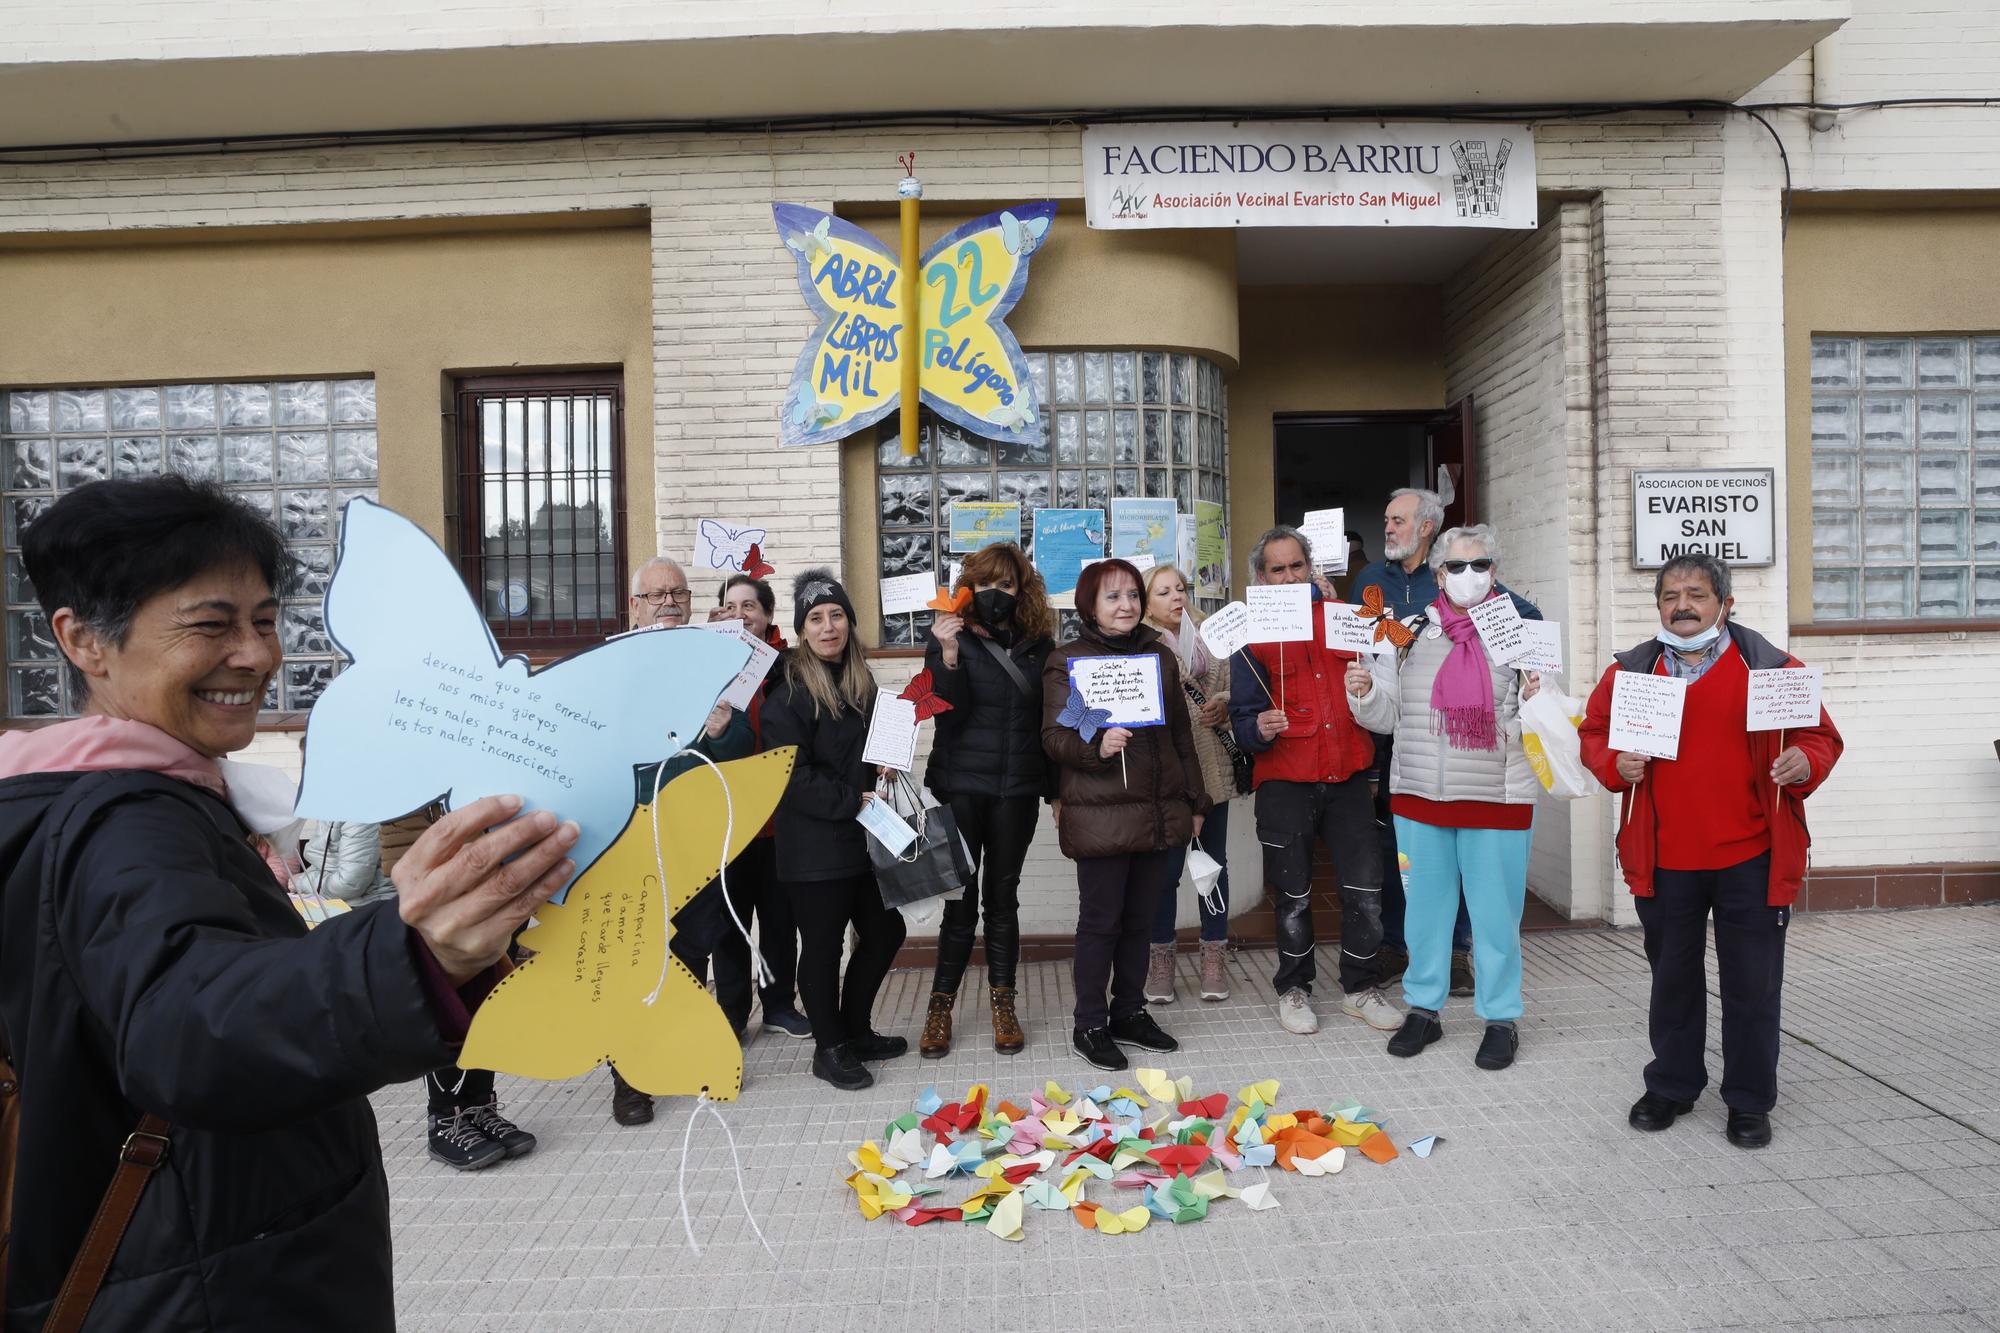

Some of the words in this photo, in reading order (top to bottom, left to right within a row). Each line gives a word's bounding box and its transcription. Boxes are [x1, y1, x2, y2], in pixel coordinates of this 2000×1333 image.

[1102, 143, 1296, 175] FACIENDO
[1301, 143, 1442, 175] BARRIU
[1153, 191, 1232, 209] Asociación
[1236, 192, 1289, 207] Vecinal
[1293, 191, 1355, 207] Evaristo
[1359, 192, 1389, 206] San
[1391, 191, 1442, 209] Miguel
[926, 240, 1001, 329] 22
[1638, 480, 1702, 488] ASOCIACION
[1705, 479, 1720, 488] DE
[1722, 478, 1767, 487] VECINOS
[1648, 495, 1759, 514] EVARISTO
[1681, 519, 1726, 537] SAN
[1661, 542, 1748, 560] MIGUEL
[438, 682, 460, 696] nos
[495, 680, 520, 695] que
[528, 691, 541, 702] se
[554, 701, 607, 731] enredar
[395, 690, 414, 708] les
[420, 699, 438, 715] tos
[487, 722, 558, 758] paradoxes
[388, 712, 407, 731] les
[414, 719, 433, 736] tos
[481, 741, 573, 789] inconscientes
[584, 892, 590, 900] a
[600, 891, 613, 915] que
[582, 908, 593, 925] mi
[631, 874, 657, 967] Camparina
[598, 919, 614, 954] tarde
[590, 960, 610, 1003] llegues
